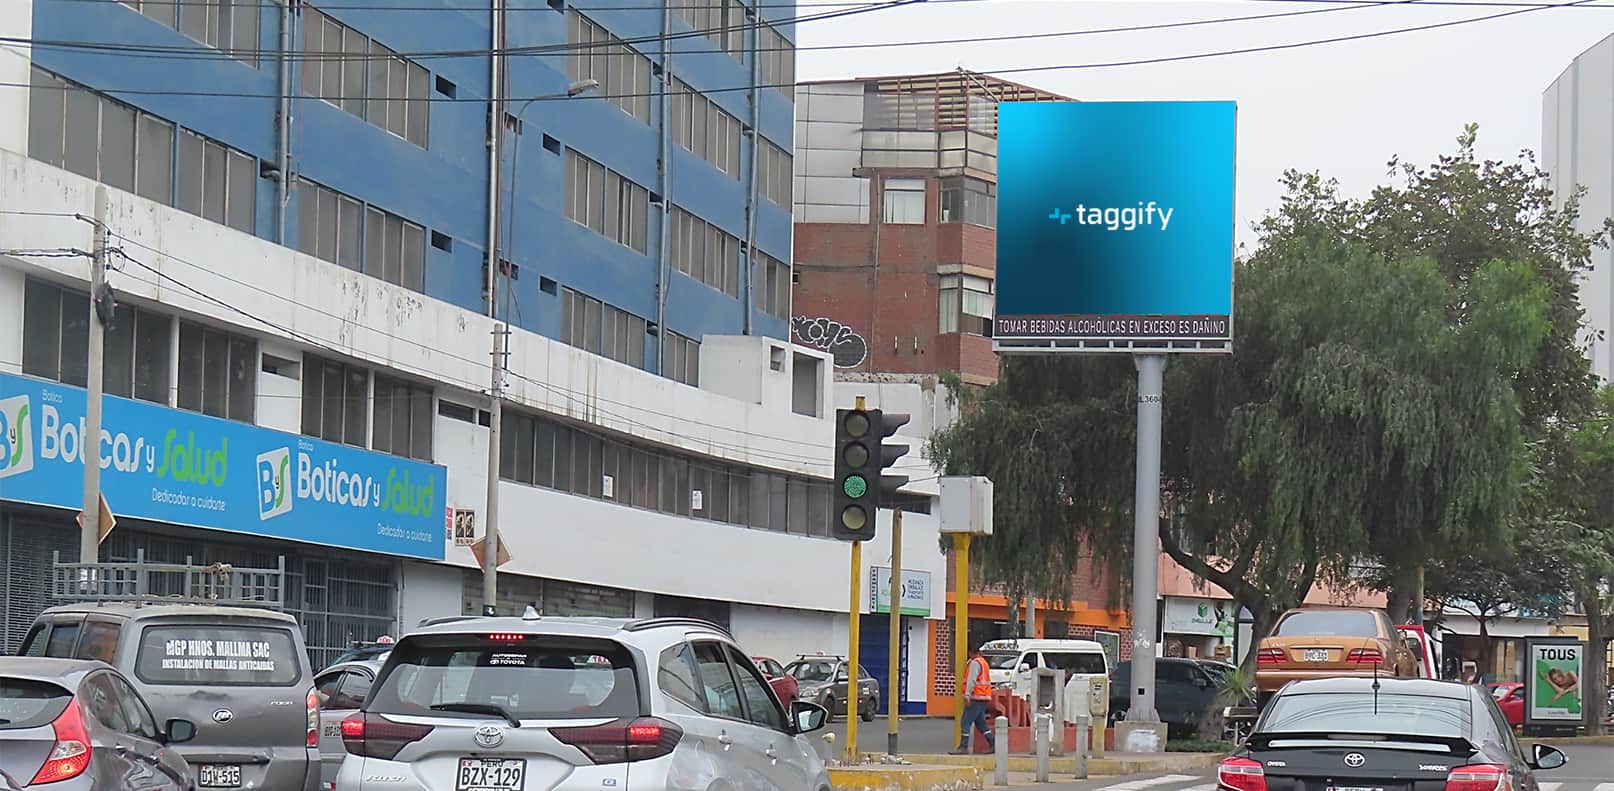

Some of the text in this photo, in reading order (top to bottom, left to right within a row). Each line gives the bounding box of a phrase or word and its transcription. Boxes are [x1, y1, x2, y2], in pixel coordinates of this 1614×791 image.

[1076, 201, 1174, 231] taggify
[999, 316, 1225, 334] TOMAR BEBIDAS ALCOHÓLICAS EN EXCESO ES DAÑINO
[41, 404, 229, 487] Botcas y Salud
[297, 453, 435, 518] Boticas y Salud
[216, 640, 252, 657] MALLMA
[252, 641, 270, 658] SAC
[1539, 648, 1576, 660] TOUS
[204, 659, 213, 670] DE
[213, 659, 238, 670] MALLAS
[461, 767, 521, 787] BZX-129
